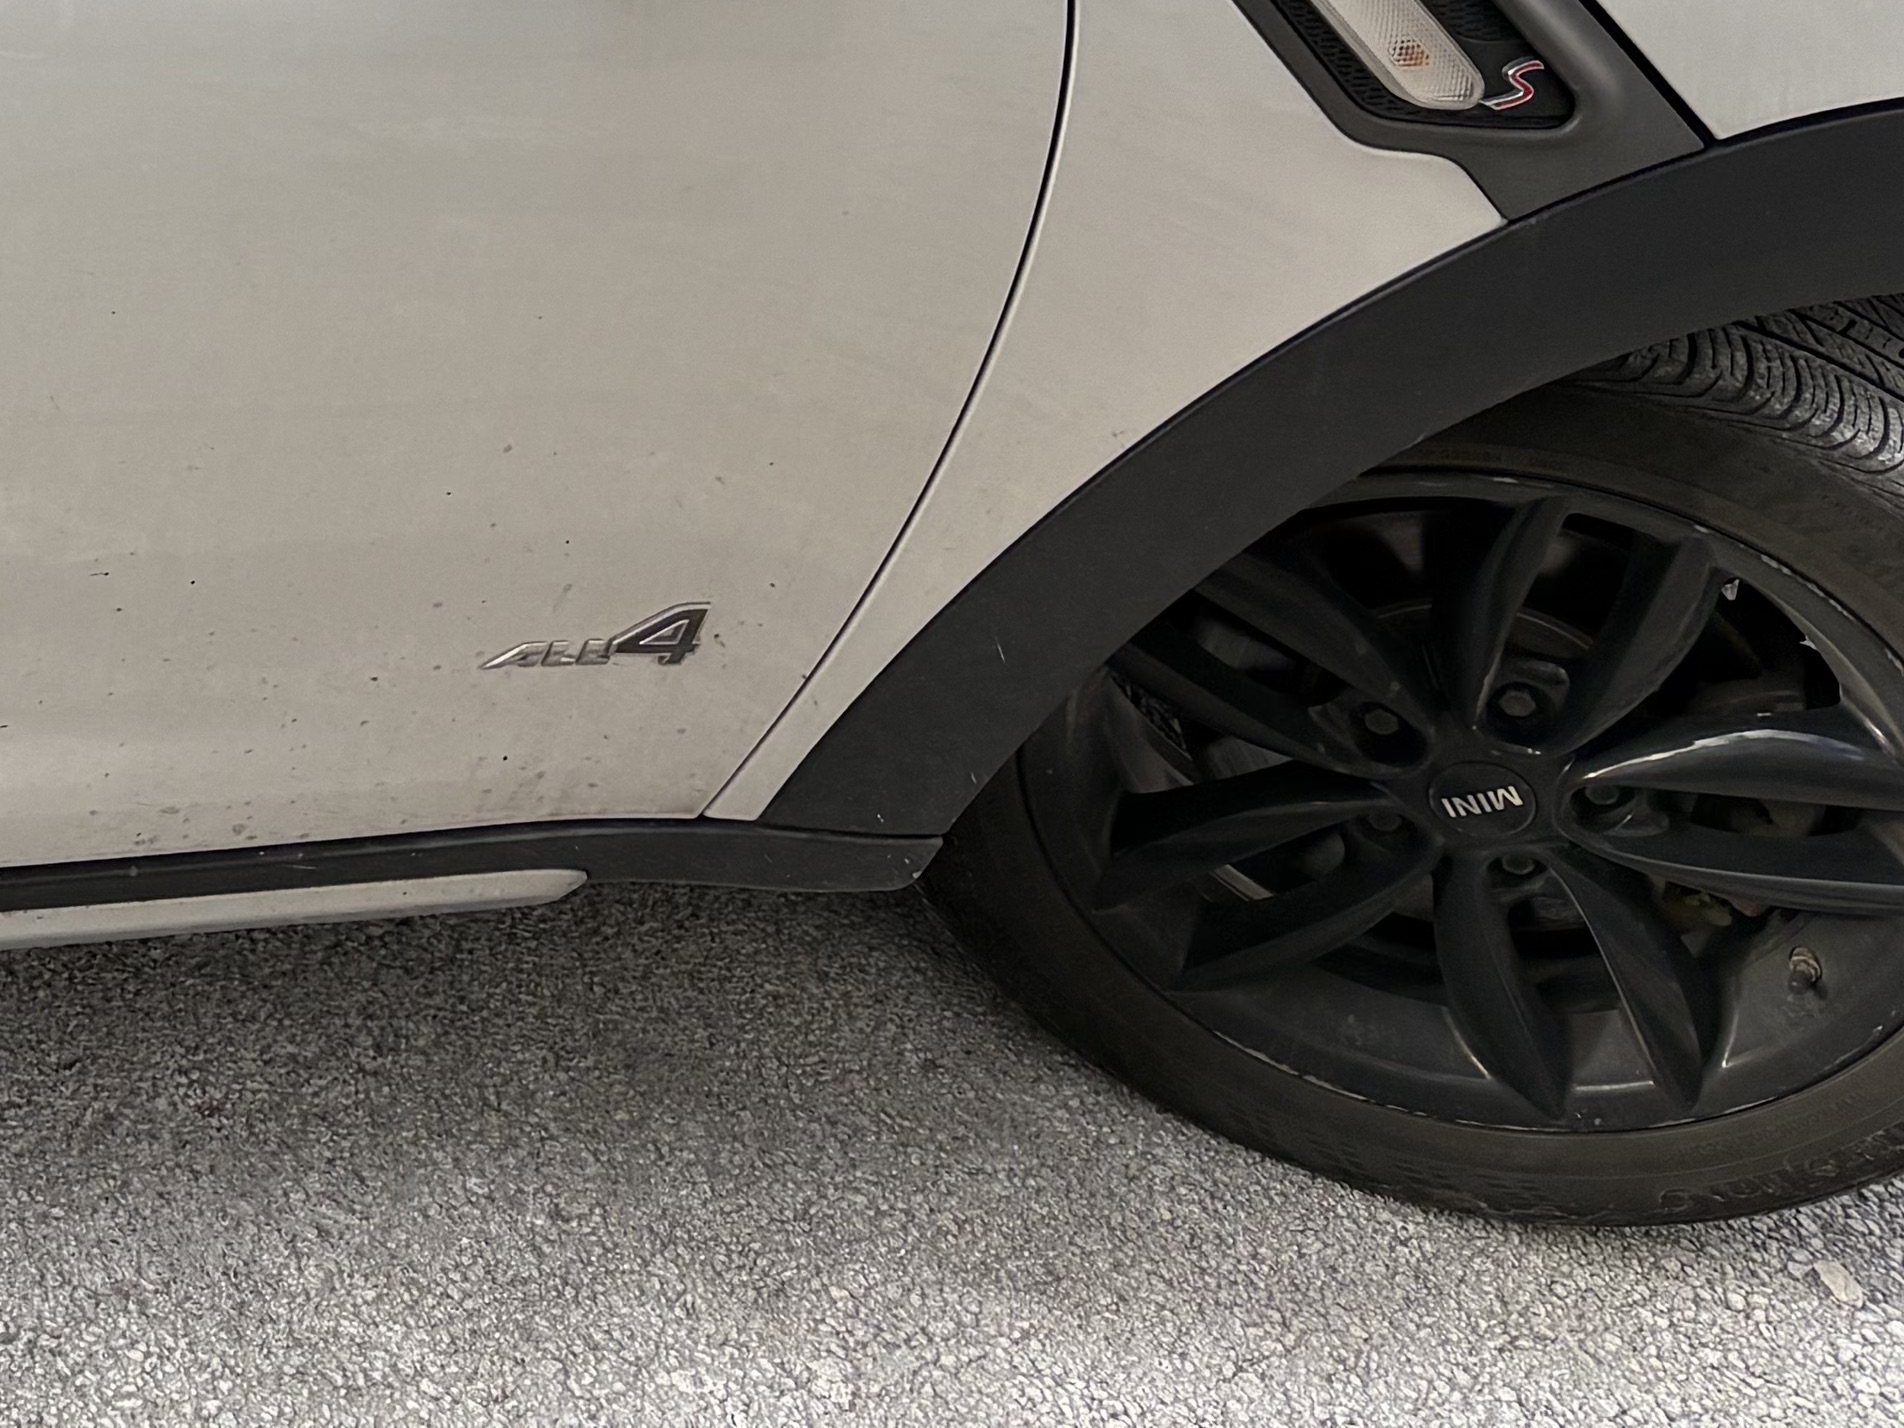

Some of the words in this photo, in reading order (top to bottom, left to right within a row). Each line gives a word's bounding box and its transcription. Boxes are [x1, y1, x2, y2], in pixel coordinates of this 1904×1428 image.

[1478, 55, 1545, 111] S
[477, 600, 713, 671] ALL4
[1441, 785, 1525, 819] MINI
